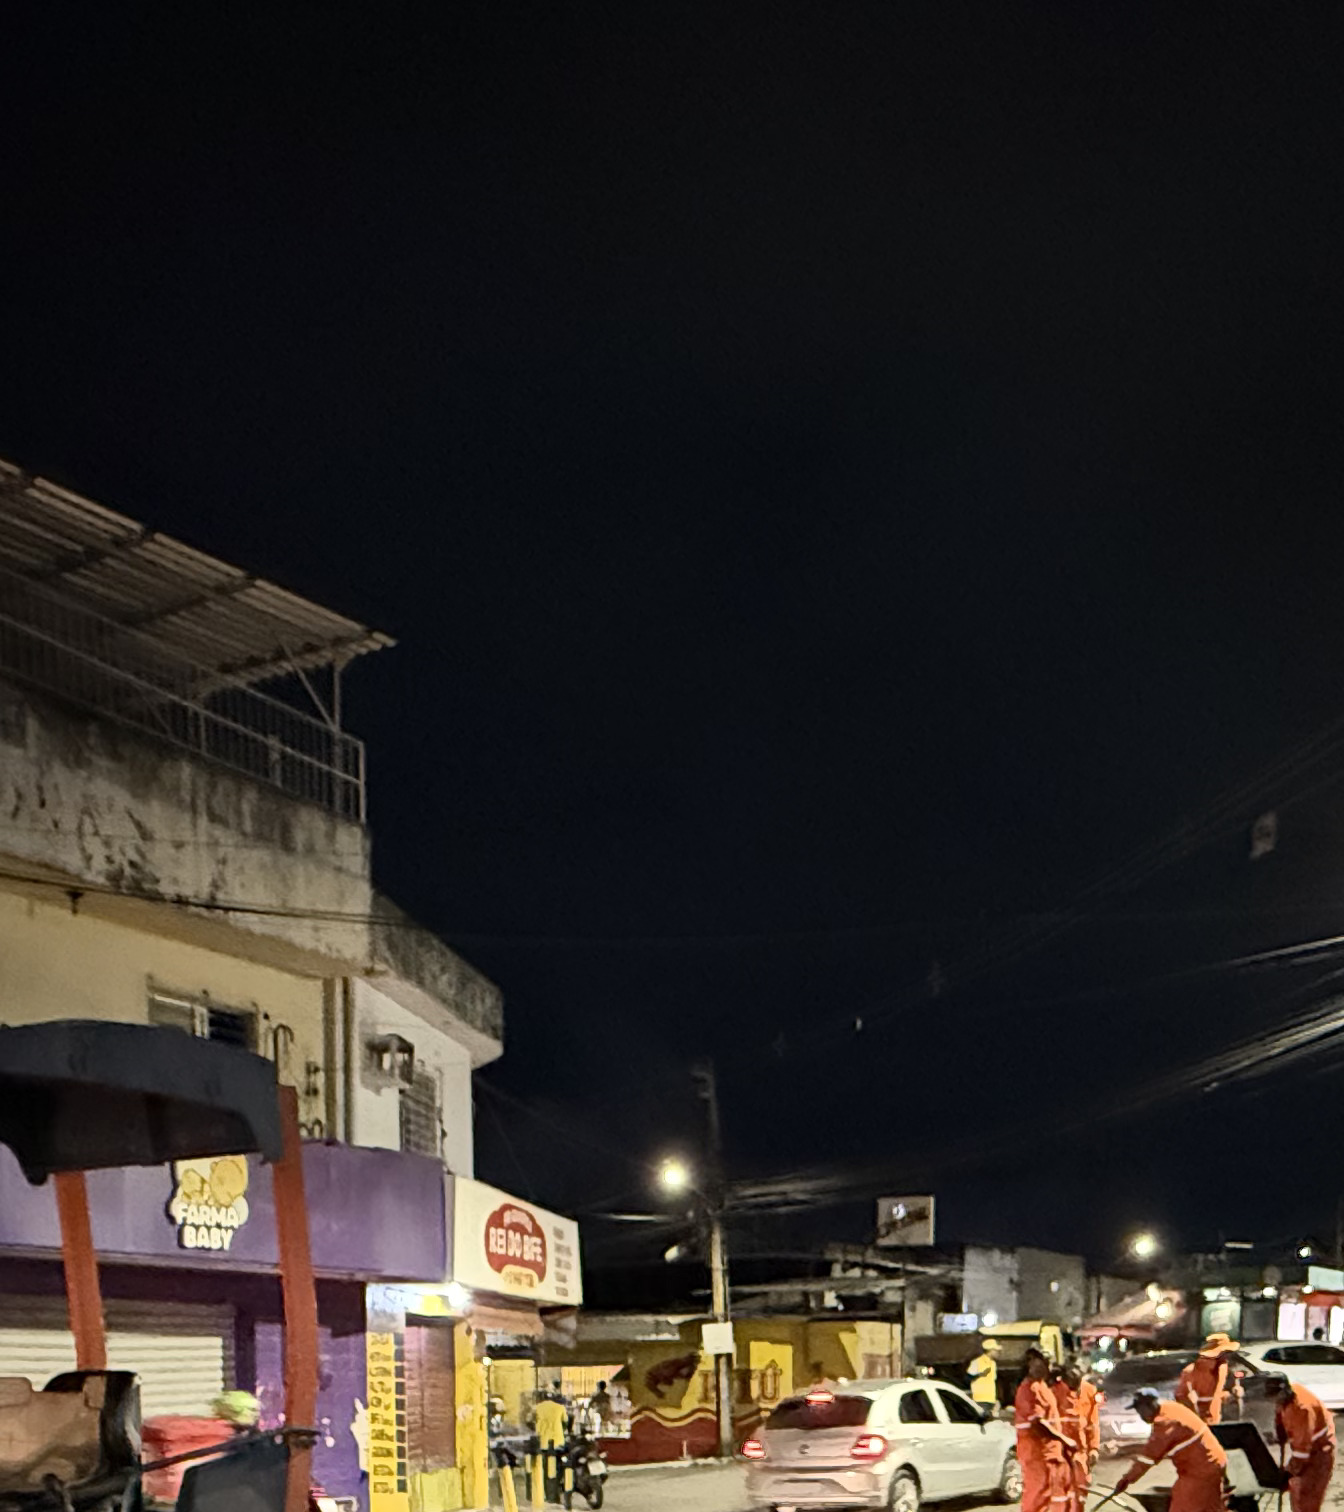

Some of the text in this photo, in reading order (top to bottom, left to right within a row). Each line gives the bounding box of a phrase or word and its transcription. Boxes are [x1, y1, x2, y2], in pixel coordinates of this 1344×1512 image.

[176, 1202, 239, 1228] FARMA
[183, 1225, 233, 1251] BABY
[489, 1227, 507, 1255] REI
